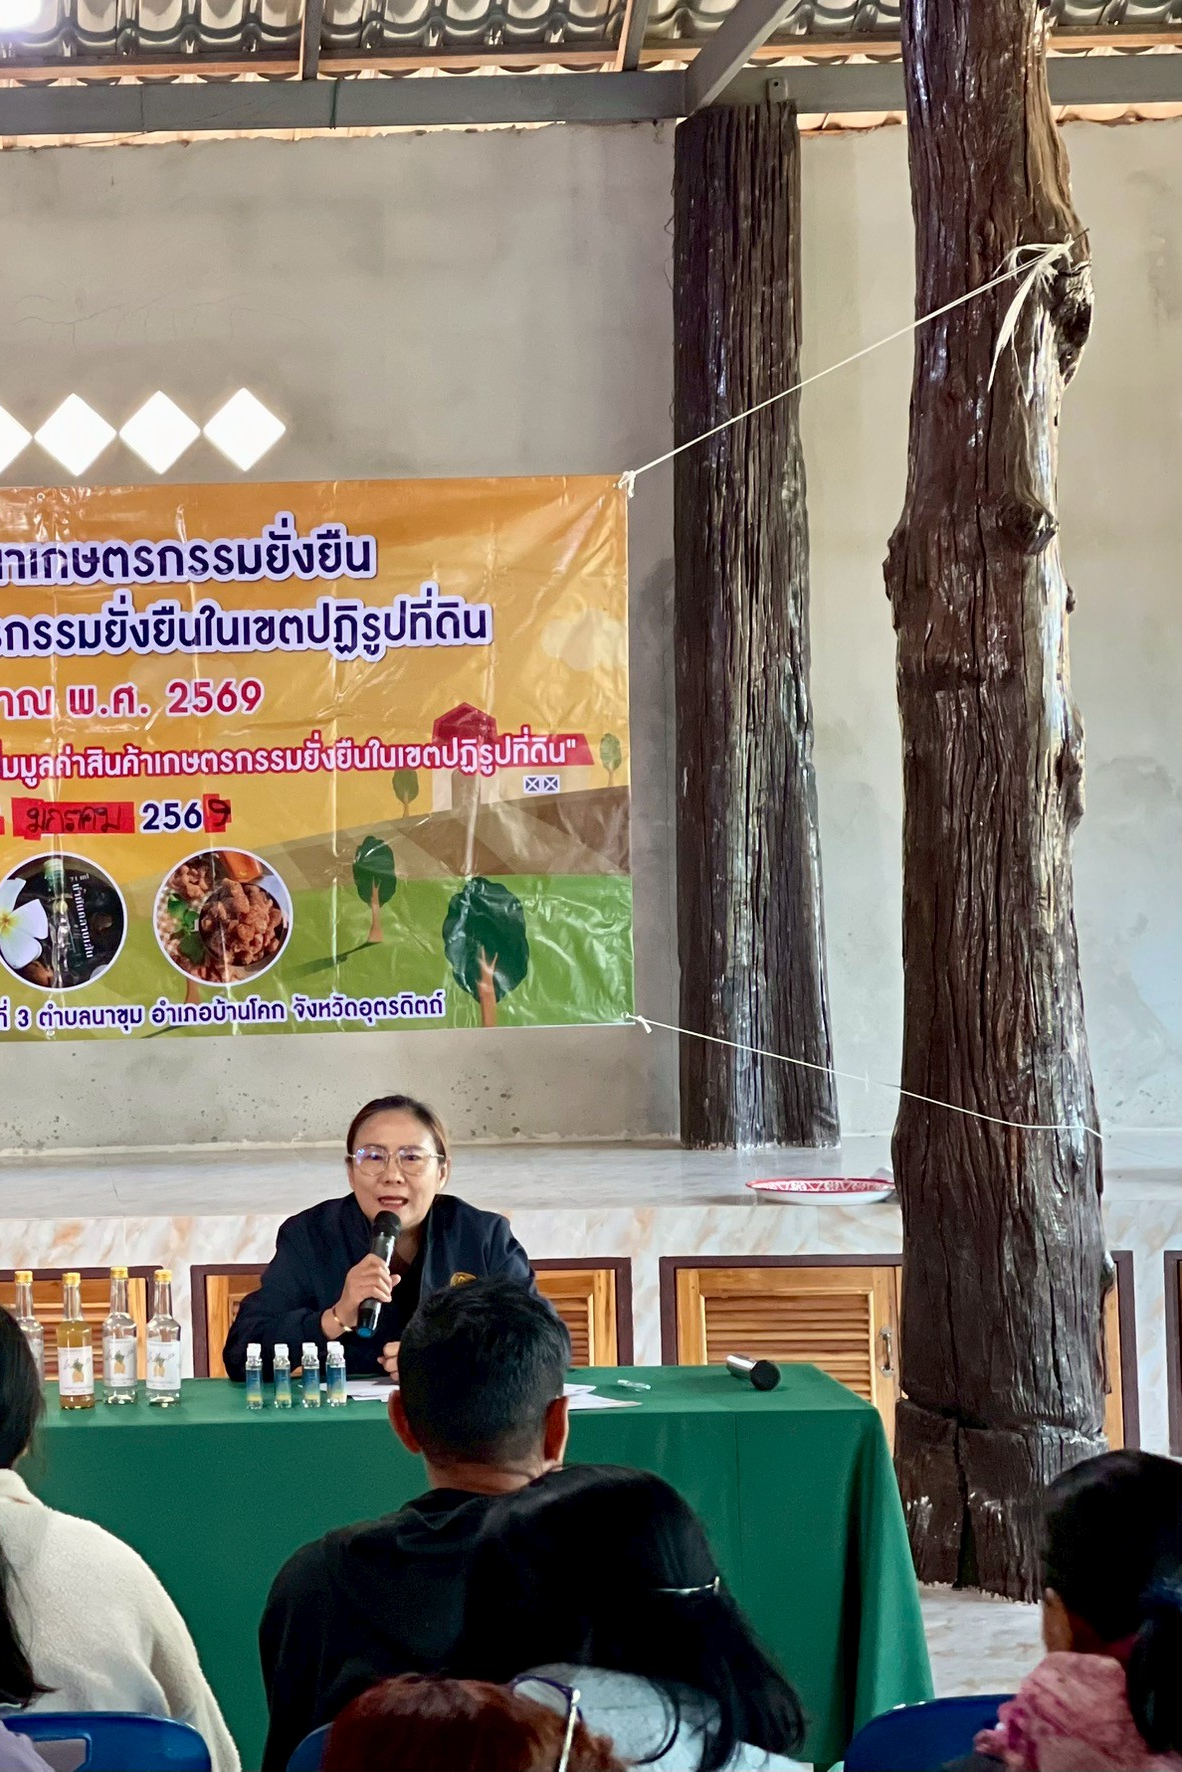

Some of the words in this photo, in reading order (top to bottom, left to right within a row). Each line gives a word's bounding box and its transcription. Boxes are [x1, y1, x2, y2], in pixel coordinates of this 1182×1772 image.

[69, 686, 149, 715] พ.ศ.
[168, 680, 262, 713] 2569
[17, 1008, 30, 1027] 3
[39, 1003, 142, 1034] ตำบลนาขุม
[152, 997, 286, 1025] อำเภอบ้านโคก
[295, 991, 446, 1026] จังหวัดอุตรดิตถ์
